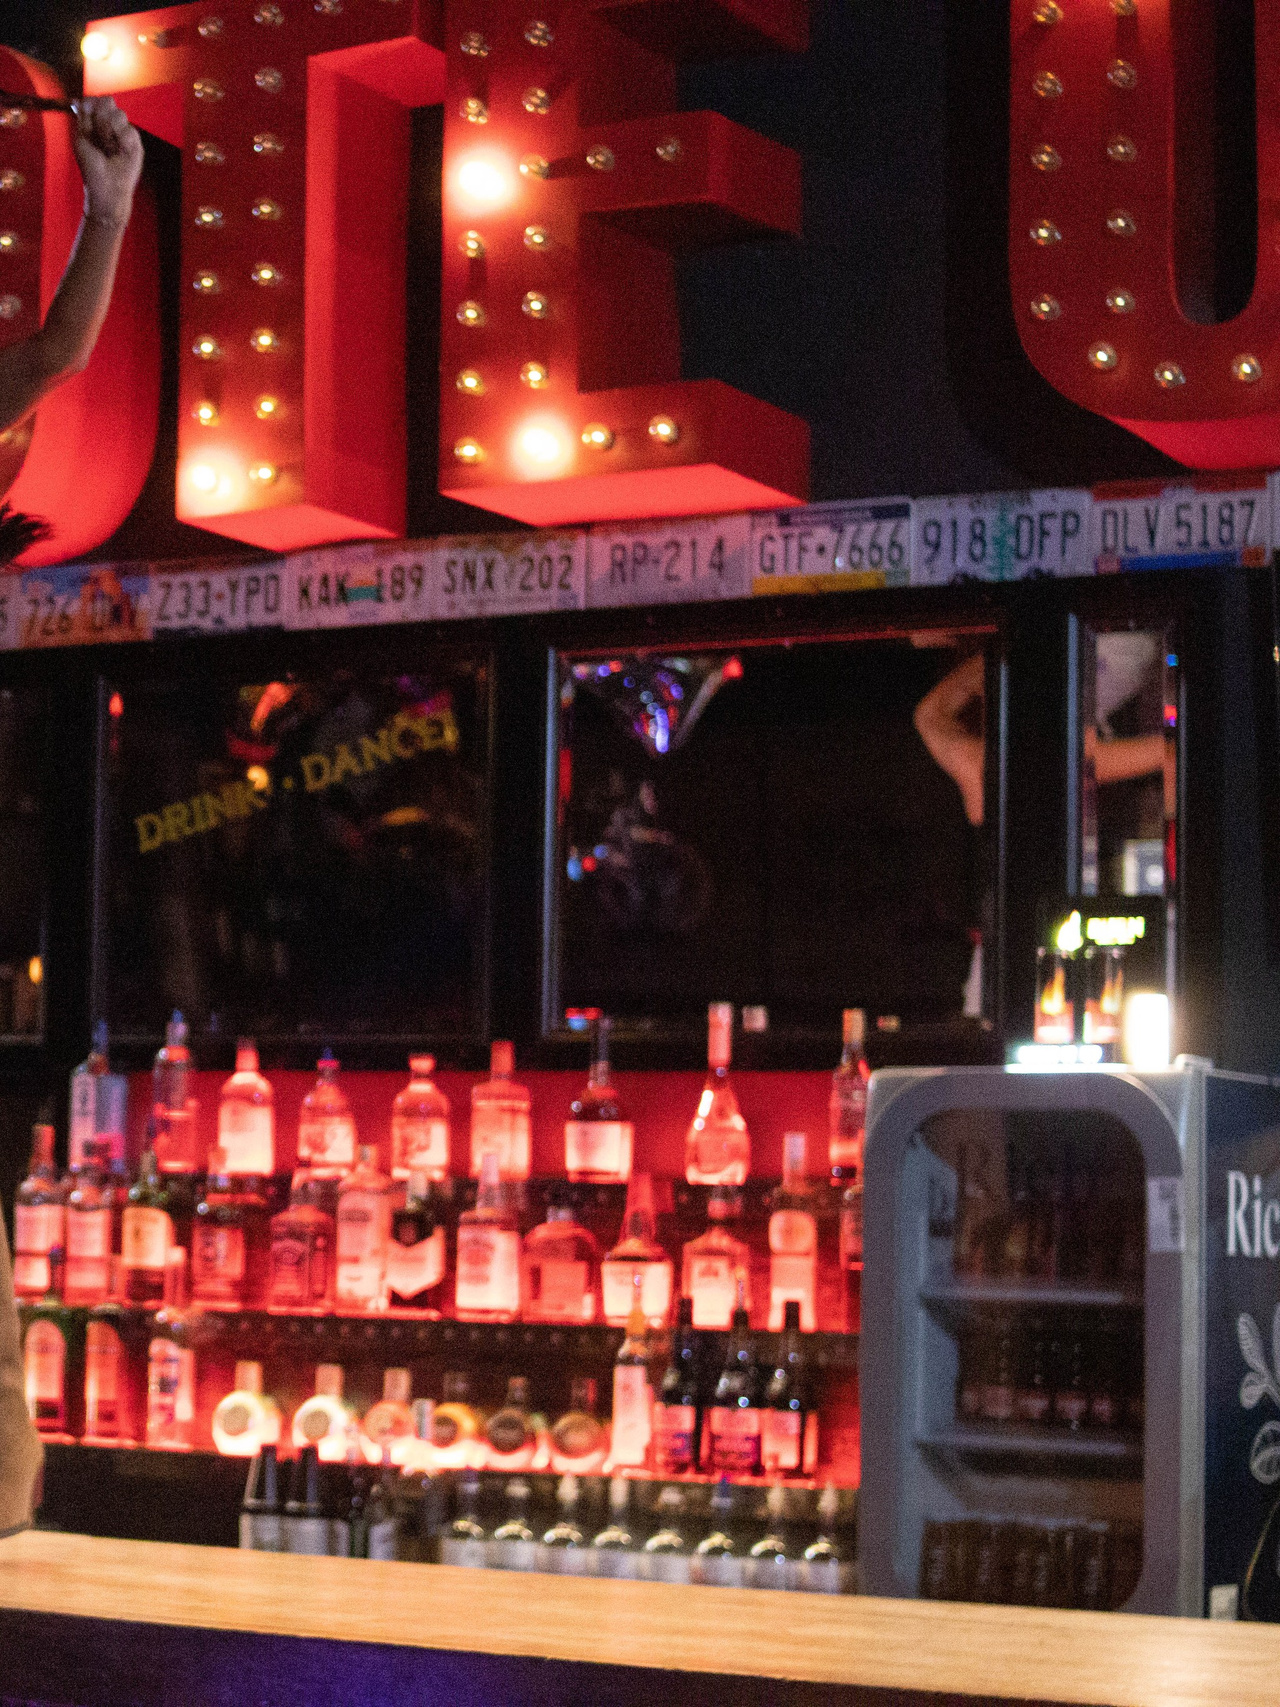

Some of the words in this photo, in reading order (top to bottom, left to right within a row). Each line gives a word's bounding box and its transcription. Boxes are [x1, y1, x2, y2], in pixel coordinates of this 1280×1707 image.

[922, 517, 988, 565] 918
[1174, 498, 1256, 549] 5187
[443, 556, 496, 595] SNX
[519, 553, 573, 592] 202
[609, 536, 727, 587] RP-214
[297, 570, 350, 611] KAK
[134, 780, 269, 854] DRINK
